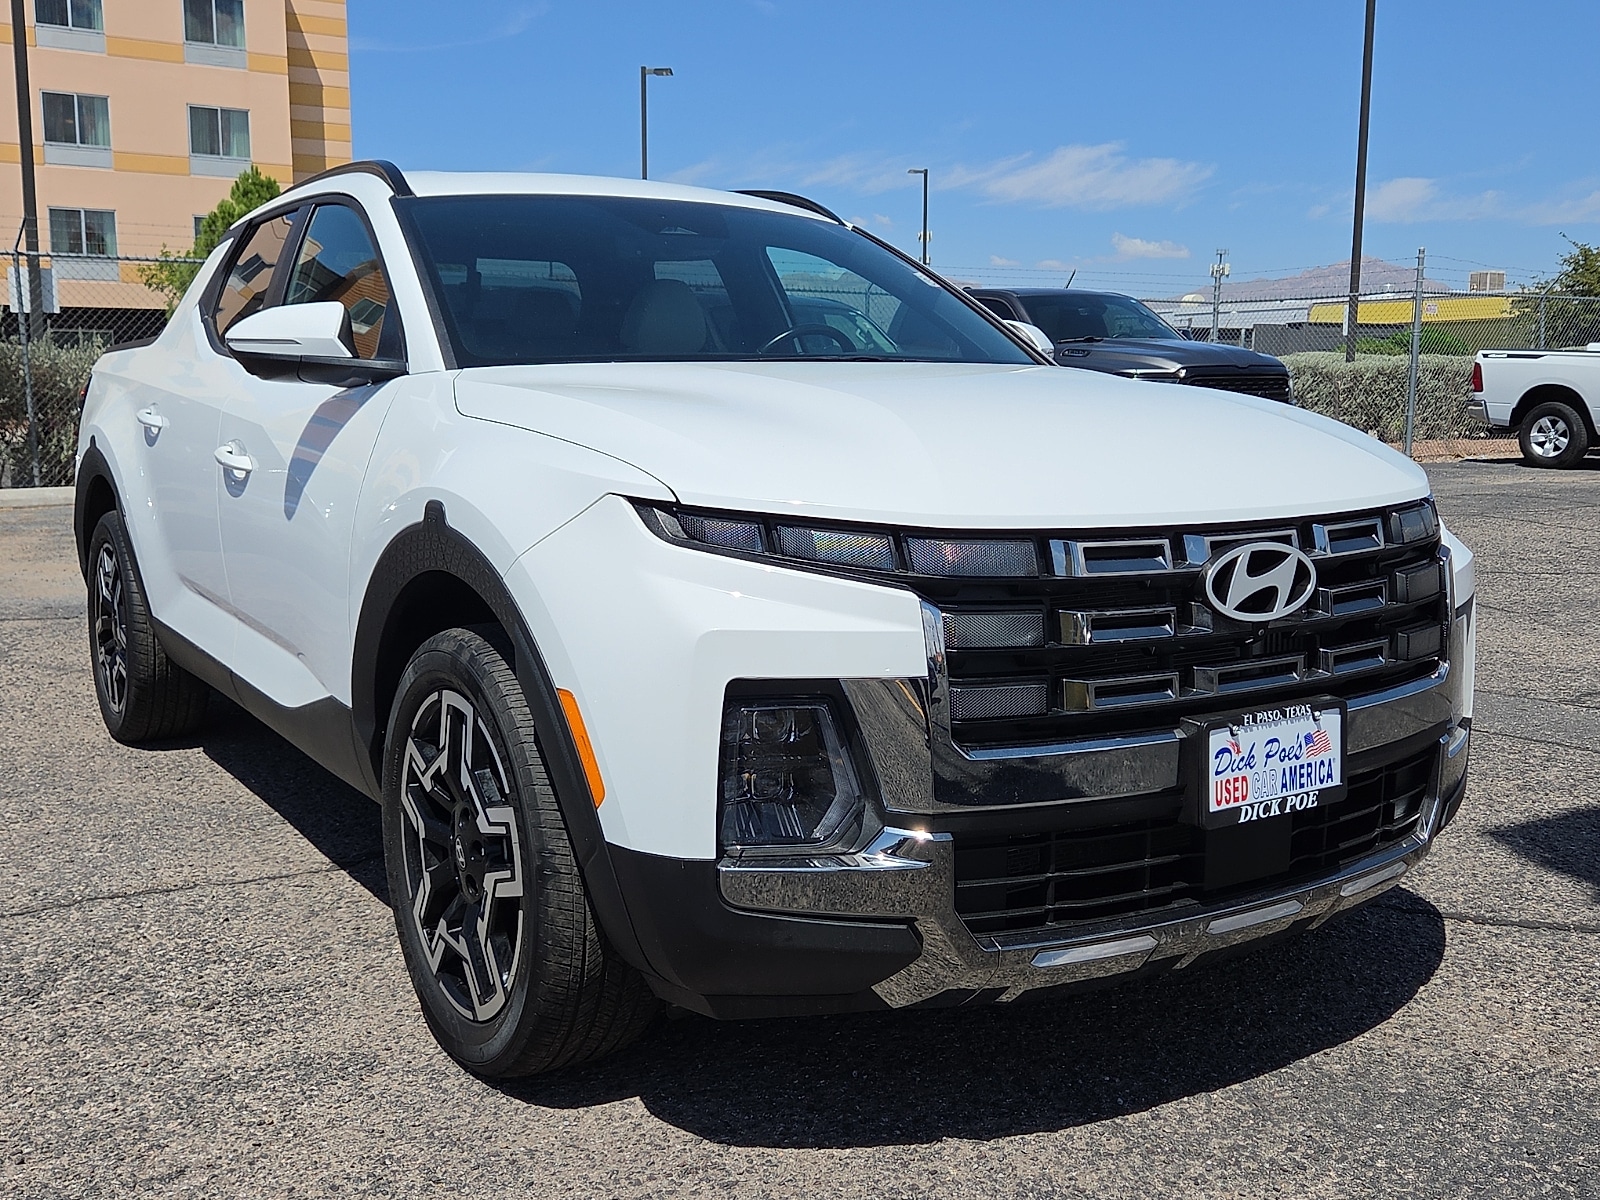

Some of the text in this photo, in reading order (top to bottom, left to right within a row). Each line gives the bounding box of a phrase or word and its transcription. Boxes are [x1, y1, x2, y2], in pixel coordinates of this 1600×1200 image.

[1243, 704, 1311, 726] EL PASO, TEXAS
[1214, 732, 1305, 777] Dick Poe's
[1215, 758, 1334, 807] USED CAR AMERICA
[1238, 790, 1319, 823] DICK POE
